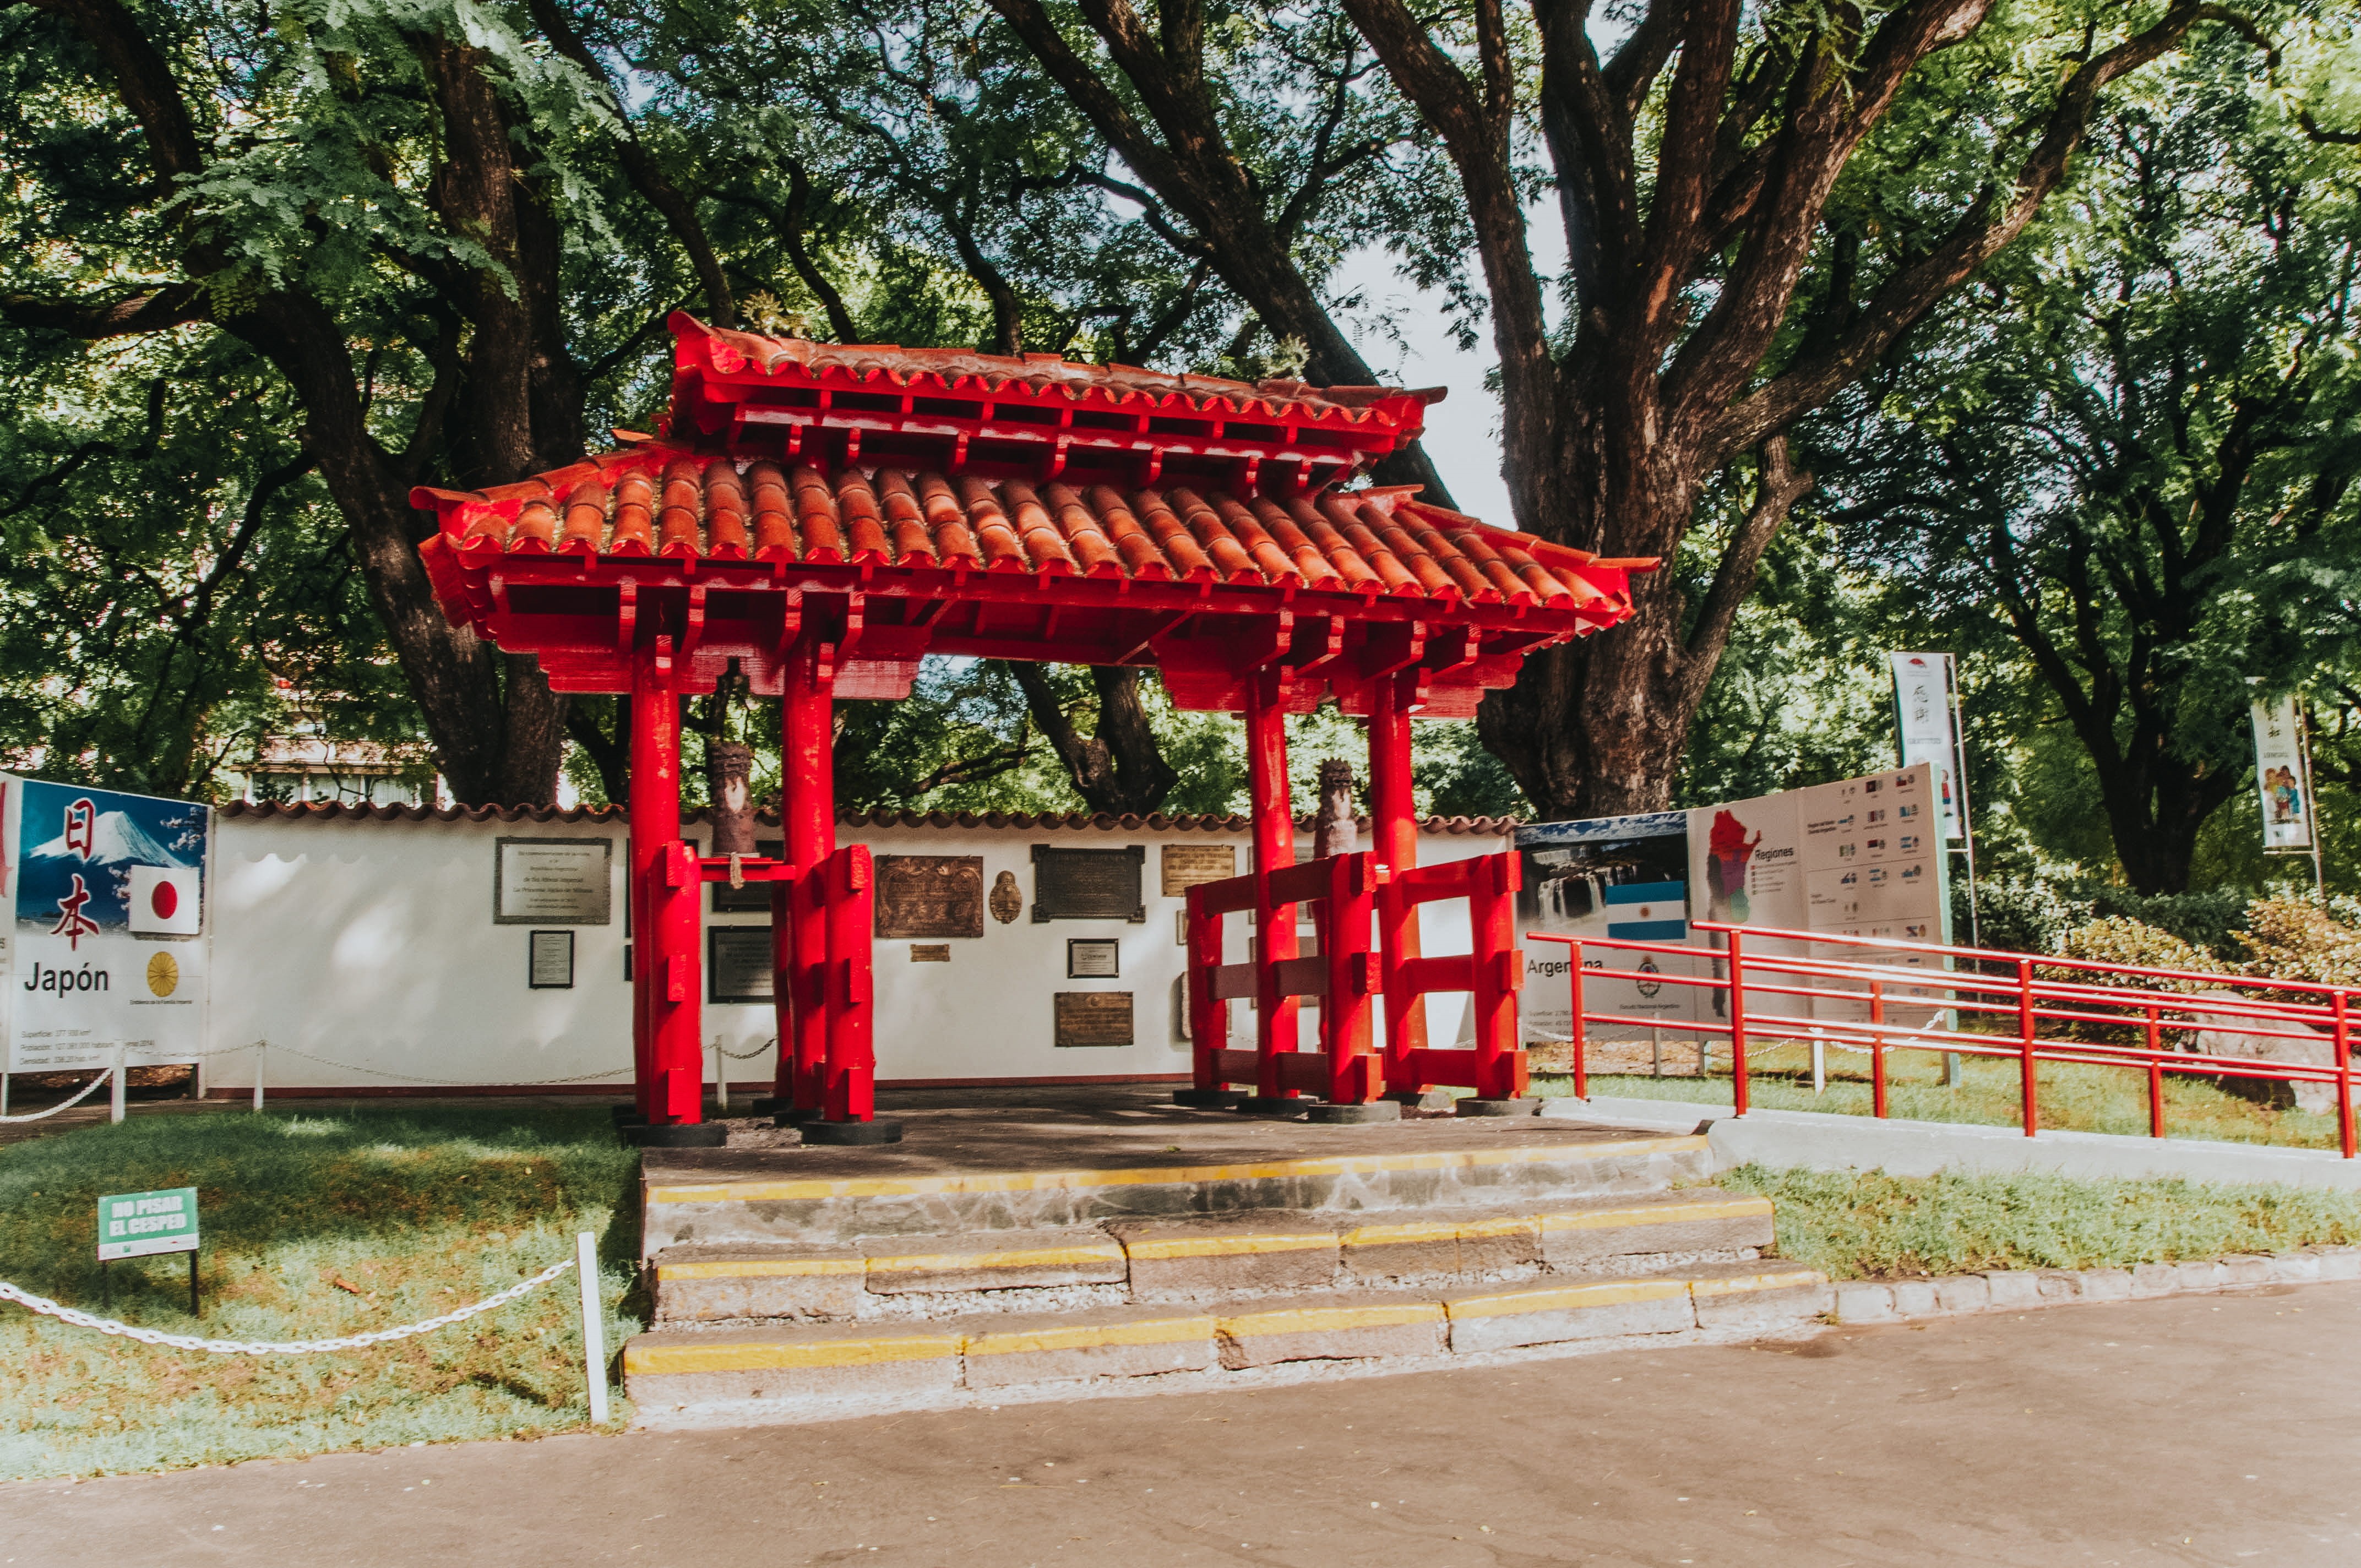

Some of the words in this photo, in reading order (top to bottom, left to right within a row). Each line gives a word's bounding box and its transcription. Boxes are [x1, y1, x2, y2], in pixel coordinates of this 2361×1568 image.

[1755, 847, 1794, 862] Regiones
[50, 797, 99, 951] 日本
[1527, 959, 1603, 977] Argenna
[24, 962, 109, 998] Japón
[112, 1201, 134, 1218] NO
[137, 1195, 183, 1216] PISAR
[109, 1220, 127, 1237] EL
[128, 1213, 187, 1234] CESPED
